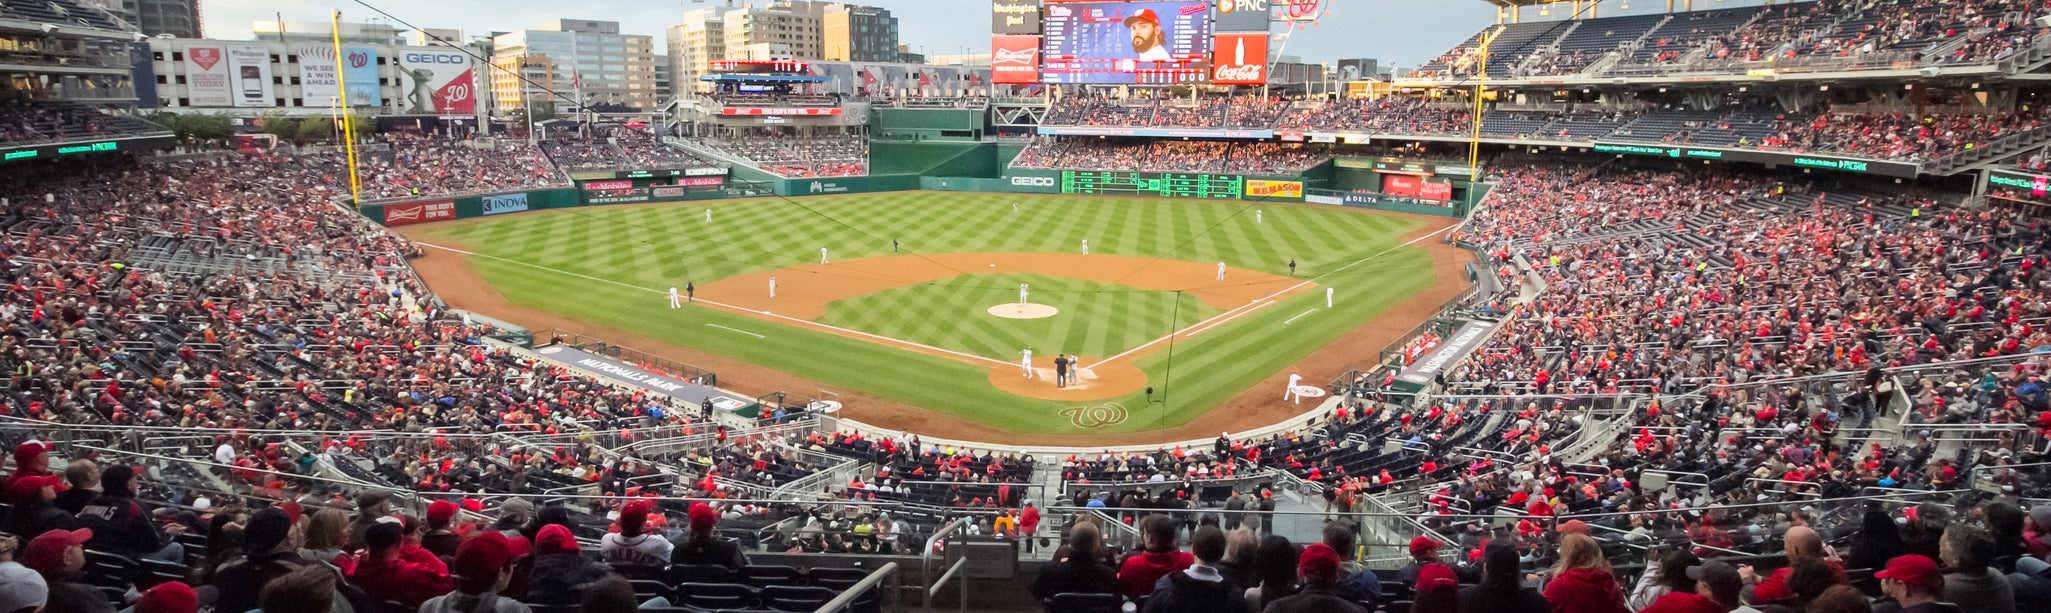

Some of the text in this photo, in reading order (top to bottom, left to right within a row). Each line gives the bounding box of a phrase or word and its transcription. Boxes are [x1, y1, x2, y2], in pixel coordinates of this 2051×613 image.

[993, 2, 1037, 15] Washington
[1179, 2, 1208, 15] Nationals
[1235, 0, 1266, 11] PNC
[406, 53, 463, 64] GEICO
[1180, 73, 1205, 81] 0 0 0
[1215, 64, 1262, 80] Coca-Cola
[194, 80, 224, 88] TODAY
[1011, 176, 1055, 186] GEICO
[494, 197, 527, 209] INOVA
[1352, 195, 1377, 203] DELTA
[577, 358, 684, 392] NATIONALS PARK
